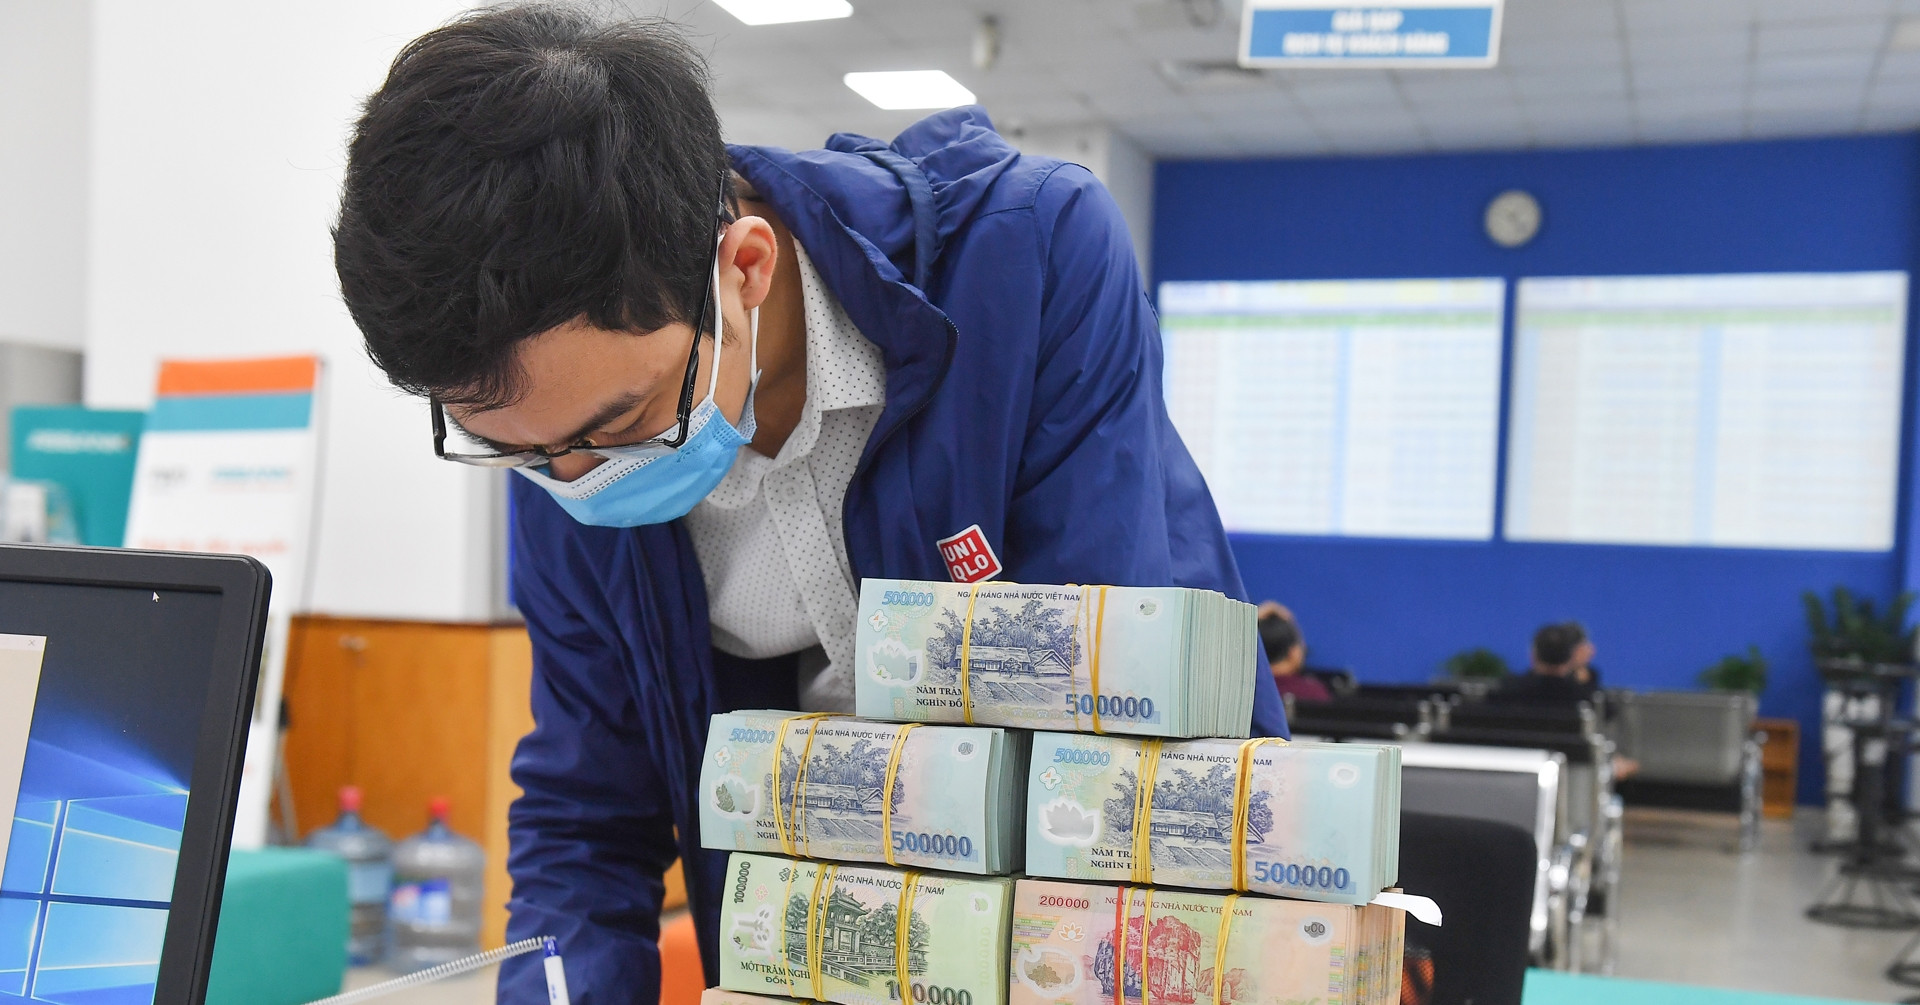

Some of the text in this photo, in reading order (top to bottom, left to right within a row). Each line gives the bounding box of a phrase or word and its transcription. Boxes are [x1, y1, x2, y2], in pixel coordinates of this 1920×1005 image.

[943, 537, 978, 562] UNI
[952, 554, 989, 582] QLO
[957, 591, 979, 599] NGN
[980, 590, 1002, 599] HÀNG
[1003, 590, 1020, 600] NHÀ
[1021, 591, 1044, 600] NƯỚC
[1045, 592, 1062, 602] VIỆT
[916, 684, 937, 695] NĂM
[916, 698, 976, 709] NGHÌN ĐỒG
[794, 727, 812, 736] NGÂ
[834, 730, 850, 738] NHÀ
[851, 731, 873, 740] NƯỚC
[874, 733, 890, 742] VIỆT
[1160, 750, 1185, 761] HÀNG
[1186, 752, 1205, 763] NHÀ
[1206, 754, 1231, 765] NƯỚC
[1252, 759, 1273, 767] NAM
[756, 818, 775, 829] NĂM
[756, 831, 781, 841] NGHÌ
[1091, 846, 1137, 859] NĂM TR
[1090, 860, 1124, 870] NGHÌN
[806, 870, 830, 880] NGN
[855, 874, 874, 887] NHÀ
[924, 885, 945, 896] NAM
[1133, 898, 1160, 909] HÀG
[1160, 900, 1181, 911] NHÀ
[1210, 905, 1224, 915] VIỆ
[1232, 908, 1253, 917] NAM
[740, 960, 812, 980] MỘT TRĂM NGHÌ
